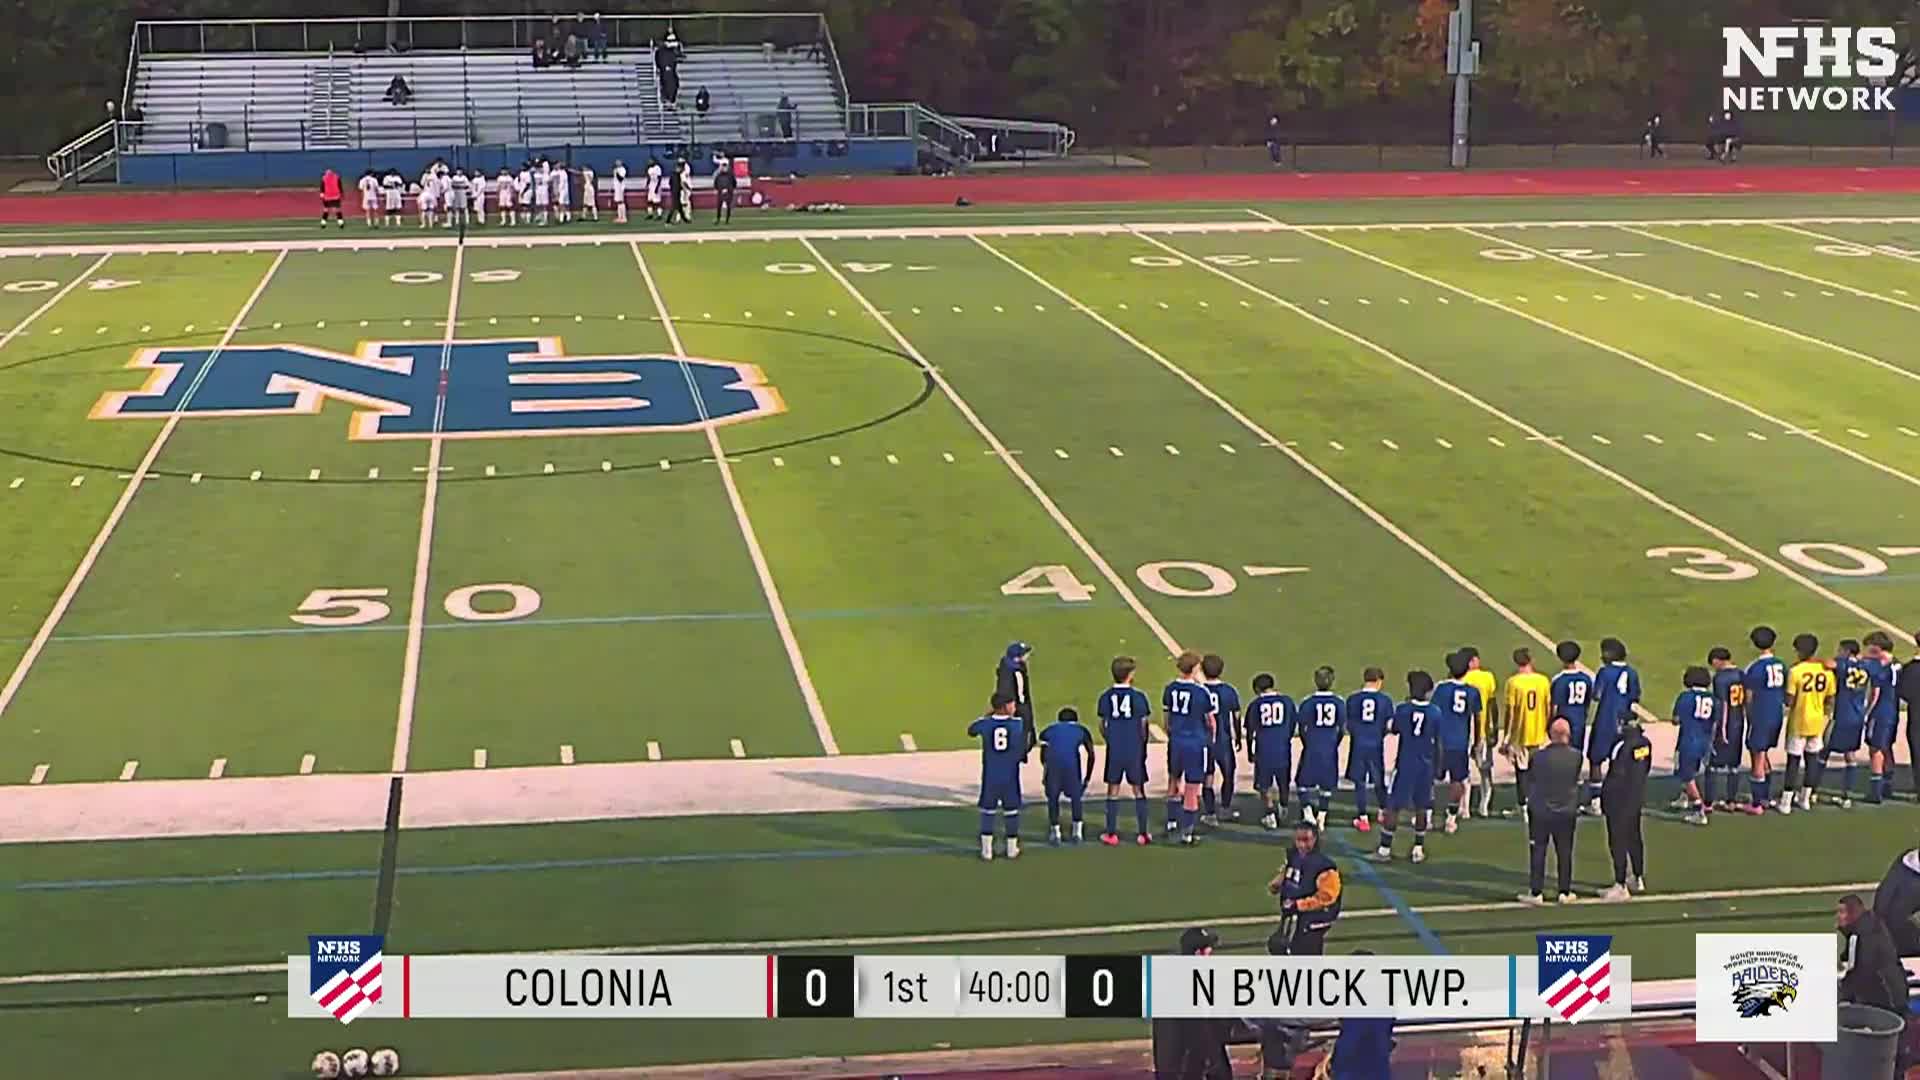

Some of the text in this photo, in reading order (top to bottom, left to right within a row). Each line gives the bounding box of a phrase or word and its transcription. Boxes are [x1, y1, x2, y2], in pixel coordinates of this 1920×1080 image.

[1568, 680, 1587, 705] 19
[1616, 671, 1628, 694] 4
[1802, 672, 1826, 692] 28
[1111, 694, 1131, 718] 14
[1171, 690, 1191, 714] 17
[1362, 698, 1376, 721] 2
[1453, 690, 1466, 713] 5
[1527, 690, 1536, 711] 0
[1260, 702, 1284, 726] 20
[1316, 703, 1336, 726] 13
[1412, 712, 1425, 736] 7
[994, 727, 1008, 751] 6
